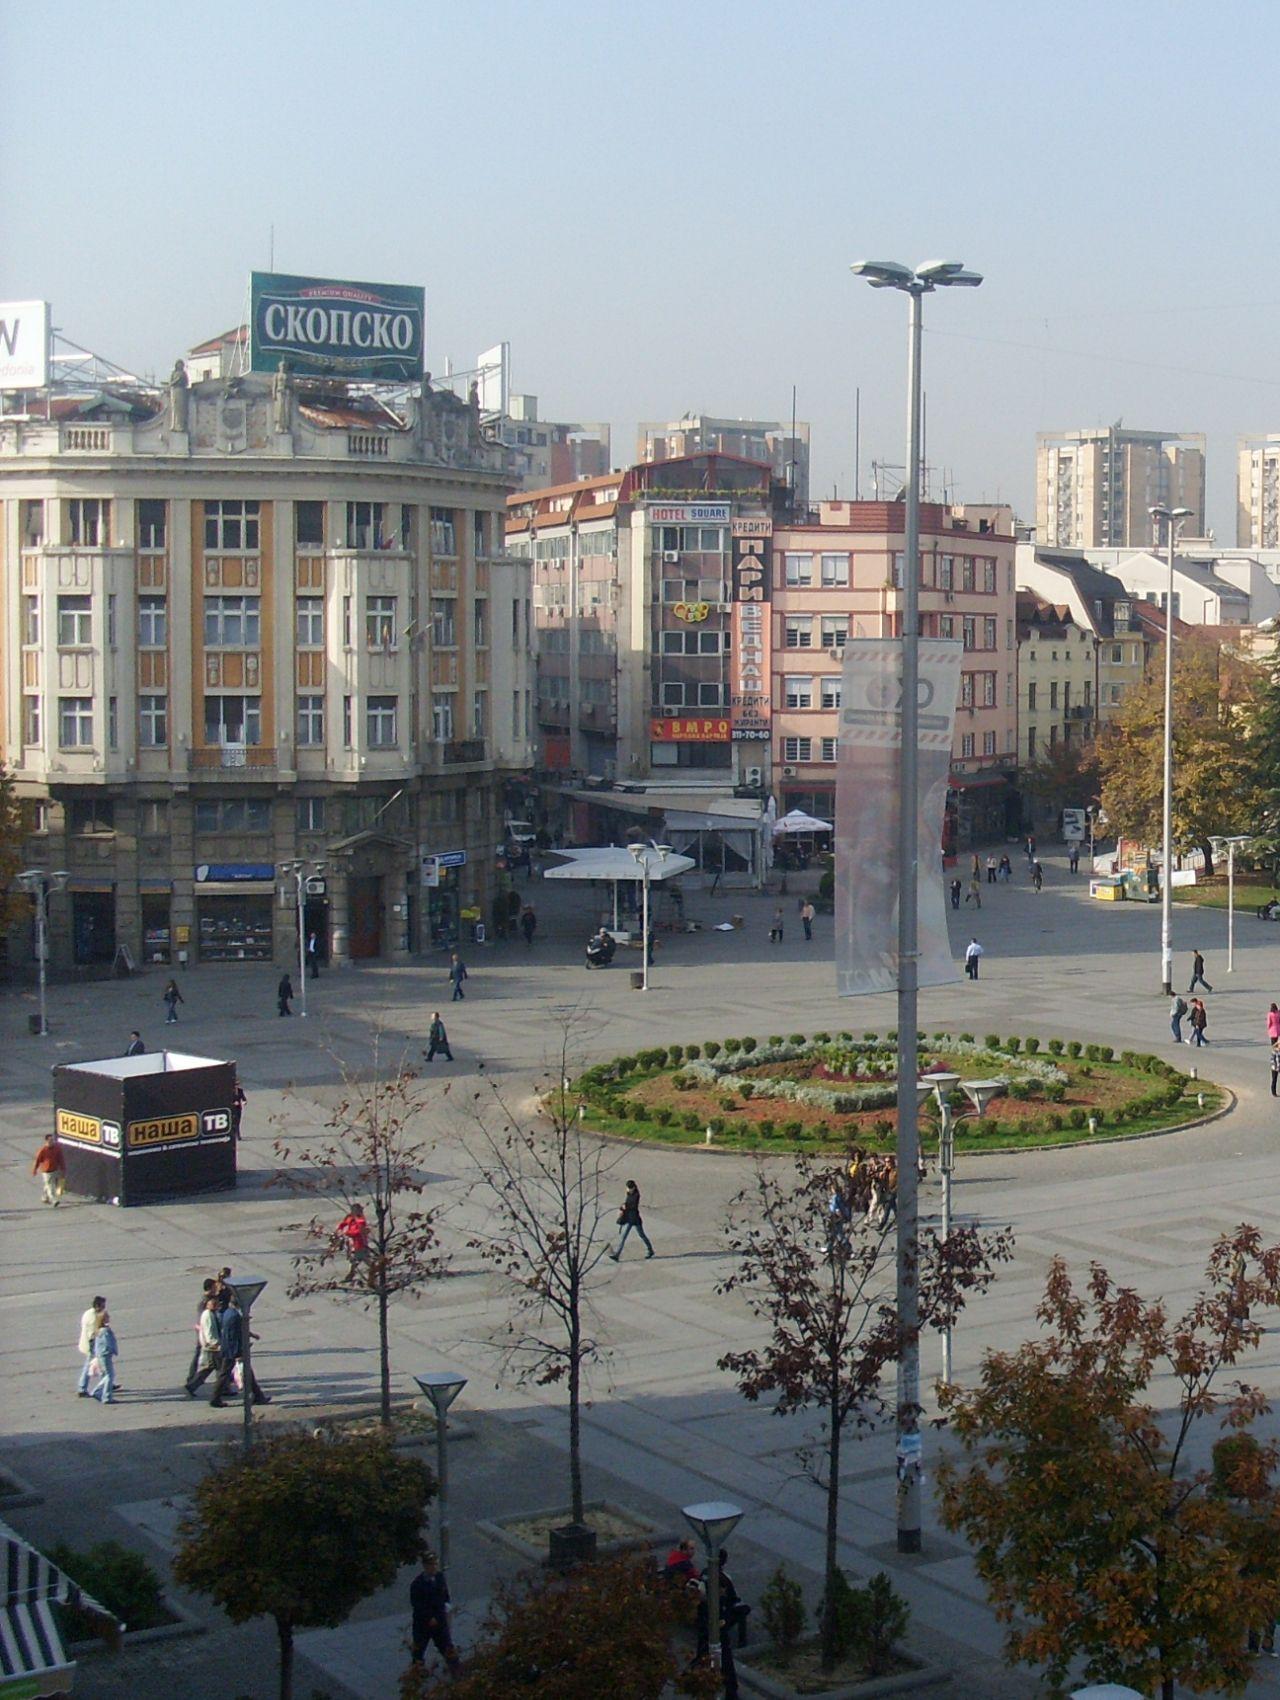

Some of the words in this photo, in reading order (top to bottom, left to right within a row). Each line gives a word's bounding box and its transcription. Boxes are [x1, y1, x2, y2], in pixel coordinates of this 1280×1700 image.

[265, 304, 413, 350] СКОПСКО
[652, 508, 687, 520] HOTEL
[691, 508, 727, 520] SQUARE
[732, 522, 771, 533] КРЕДИТИ
[737, 540, 764, 601] ПАРИ
[671, 721, 728, 733] ВМРО
[61, 1115, 97, 1138] наша
[102, 1125, 119, 1144] ТВ
[134, 1118, 193, 1142] наша
[203, 1113, 229, 1131] ТВ
